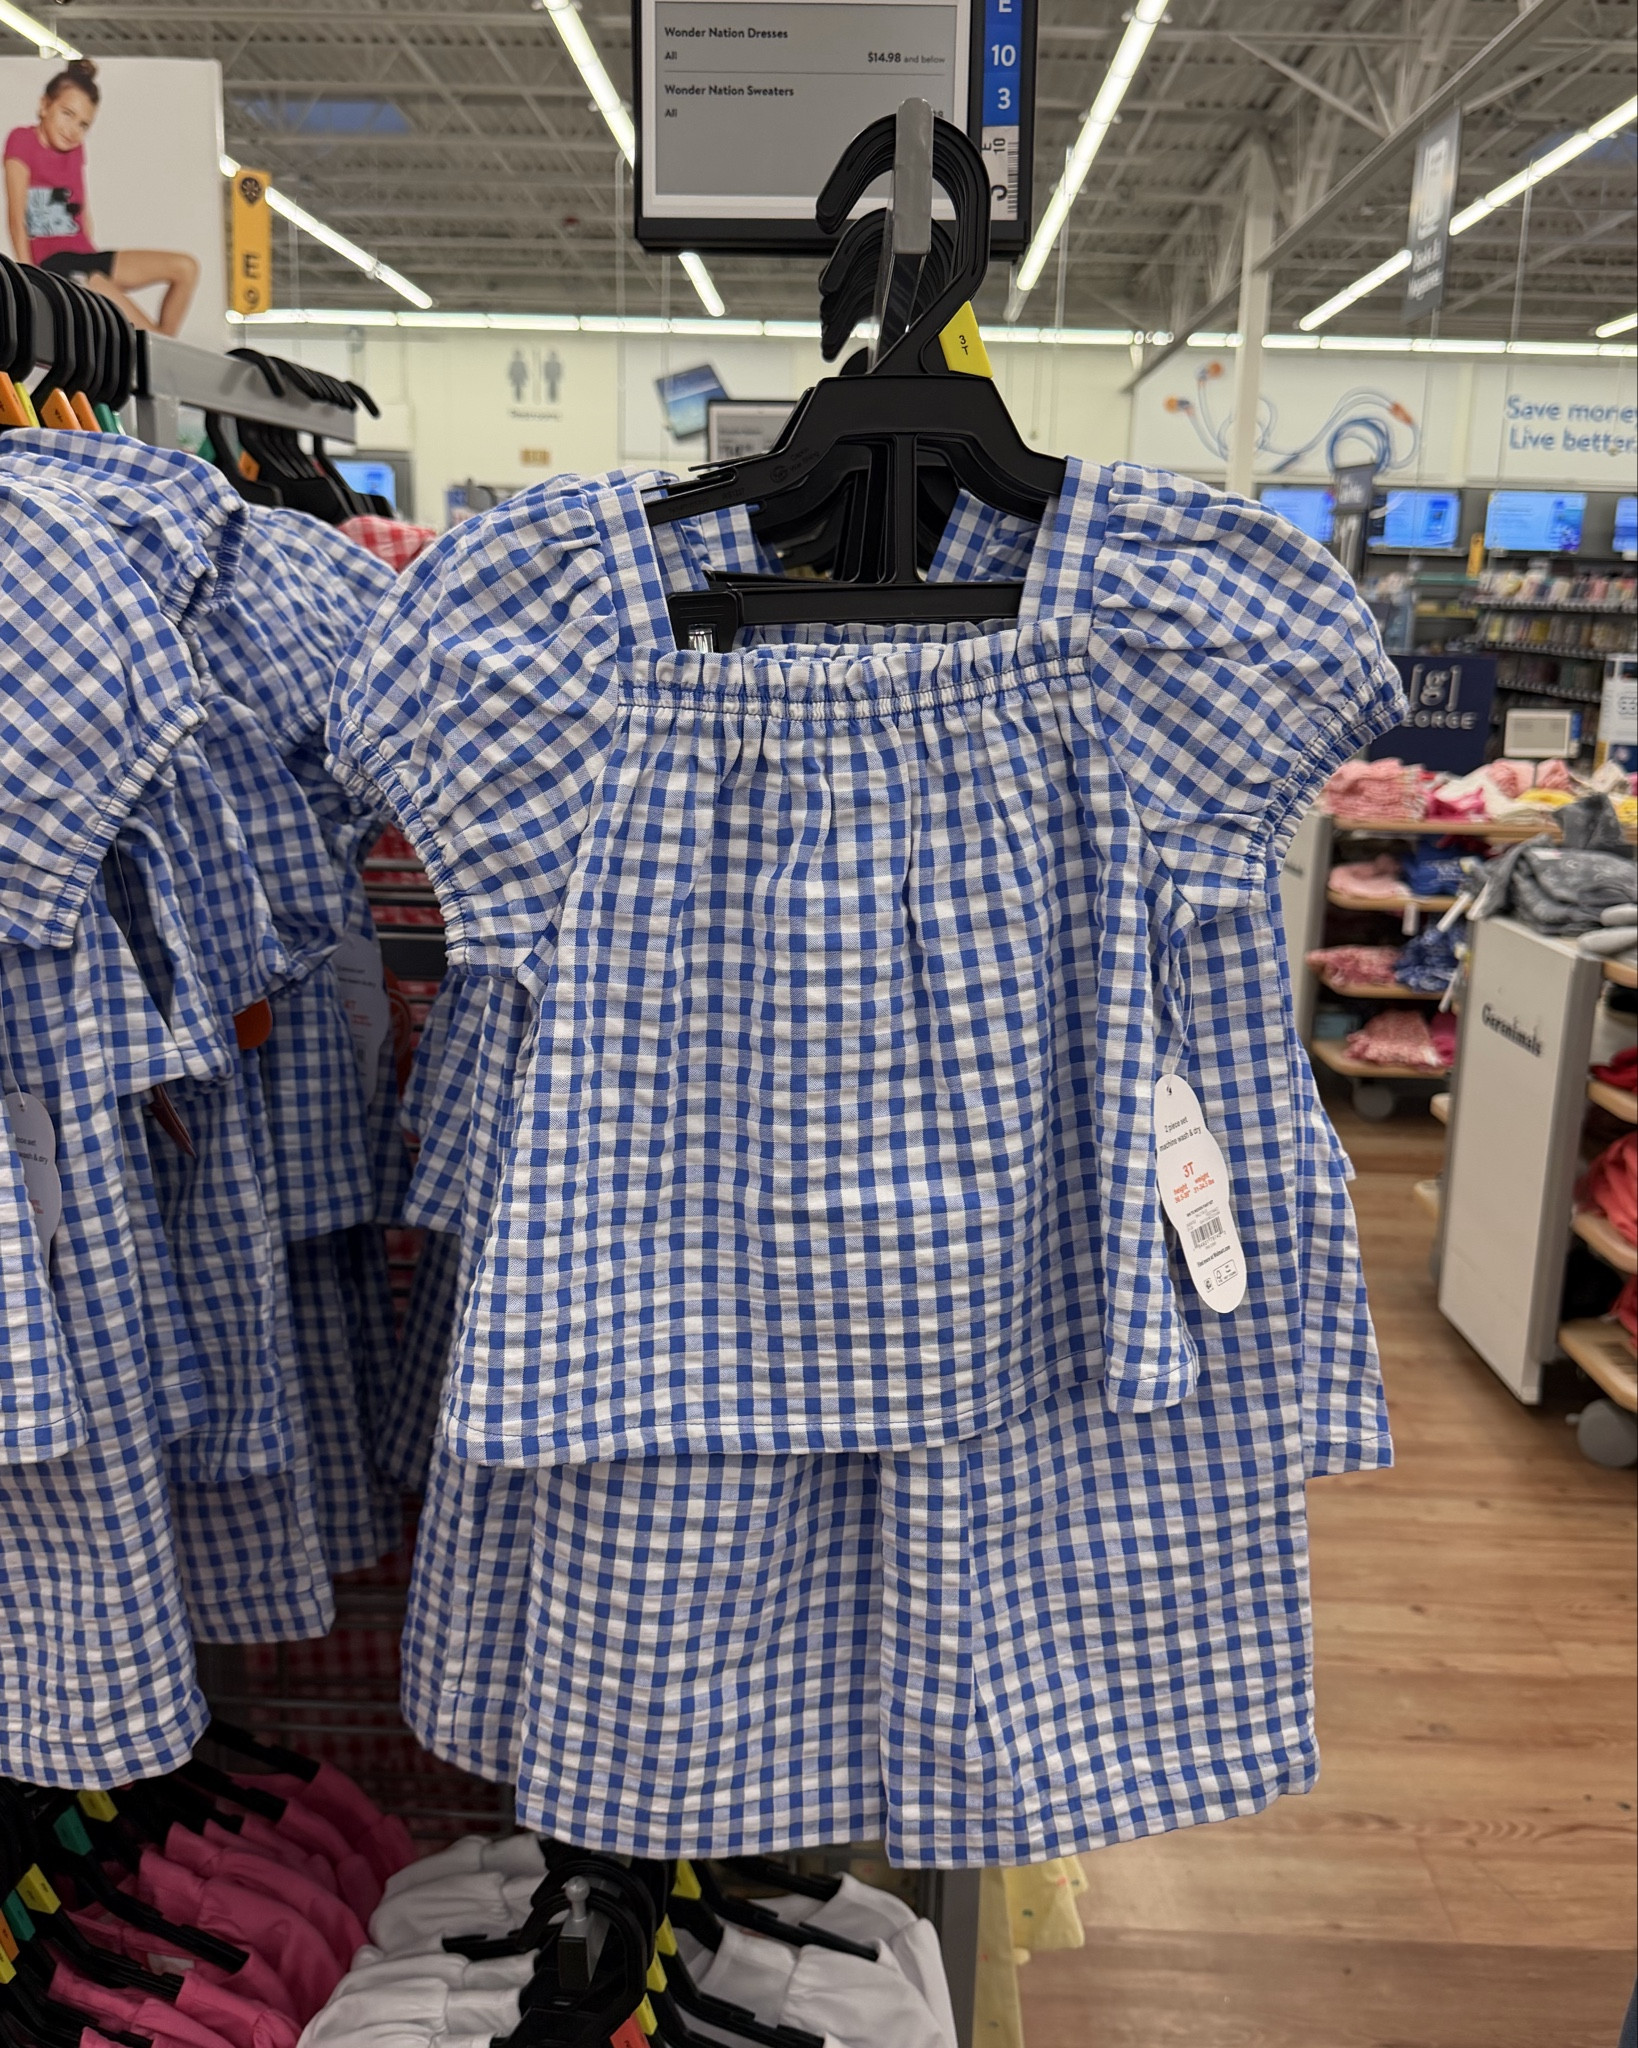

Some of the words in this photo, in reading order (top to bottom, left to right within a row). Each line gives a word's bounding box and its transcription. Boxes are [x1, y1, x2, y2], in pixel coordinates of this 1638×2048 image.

[664, 27, 706, 38] Wonder
[708, 27, 745, 39] Nation
[747, 28, 788, 39] Dresses
[664, 51, 678, 61] All
[868, 51, 902, 63] $14.98
[904, 55, 919, 63] and
[921, 55, 945, 64] below
[991, 44, 1016, 67] 10
[664, 84, 706, 96] Wonder
[708, 85, 745, 97] Nation
[747, 85, 794, 97] Sweaters
[997, 87, 1011, 110] 3
[664, 109, 678, 118] All
[993, 138, 1006, 155] 10
[244, 253, 261, 279] E
[959, 334, 967, 345] 3
[961, 345, 969, 355] T
[1507, 395, 1561, 420] Save
[1567, 403, 1638, 424] mone
[1510, 425, 1555, 450] Live
[1400, 711, 1478, 730] EORGE
[1482, 1002, 1542, 1057] Geranimals
[1164, 1124, 1169, 1133] 2
[1168, 1120, 1180, 1133] piece
[1159, 1138, 1178, 1152] machine
[1177, 1131, 1190, 1142] wash
[1193, 1126, 1202, 1135] dry
[1183, 1161, 1194, 1178] 3T
